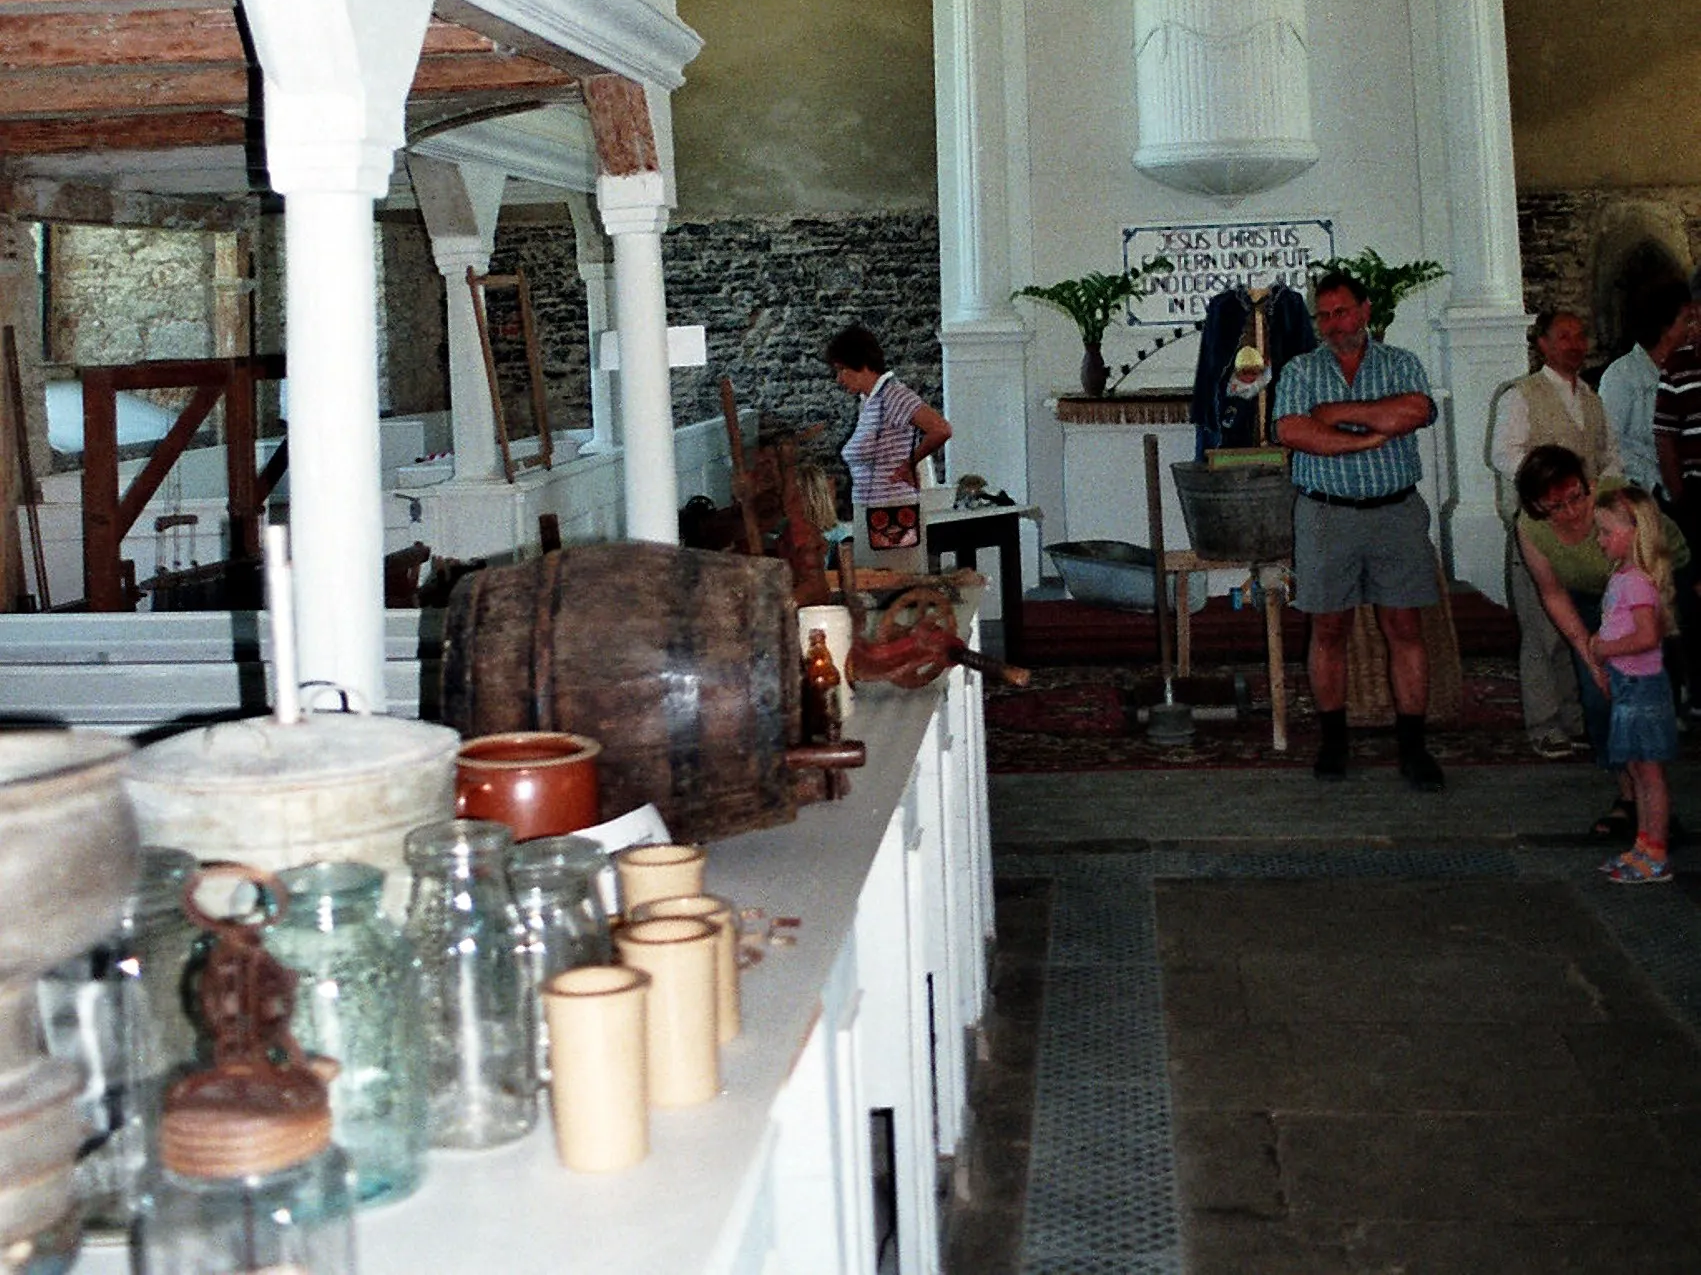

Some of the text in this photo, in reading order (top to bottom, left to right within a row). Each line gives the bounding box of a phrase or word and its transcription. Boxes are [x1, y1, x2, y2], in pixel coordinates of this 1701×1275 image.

[1156, 226, 1300, 252] JESUS CHRISTUS
[1141, 252, 1216, 272] GTERN
[1220, 249, 1257, 270] UND
[1143, 274, 1179, 295] UND
[1168, 297, 1185, 314] IN
